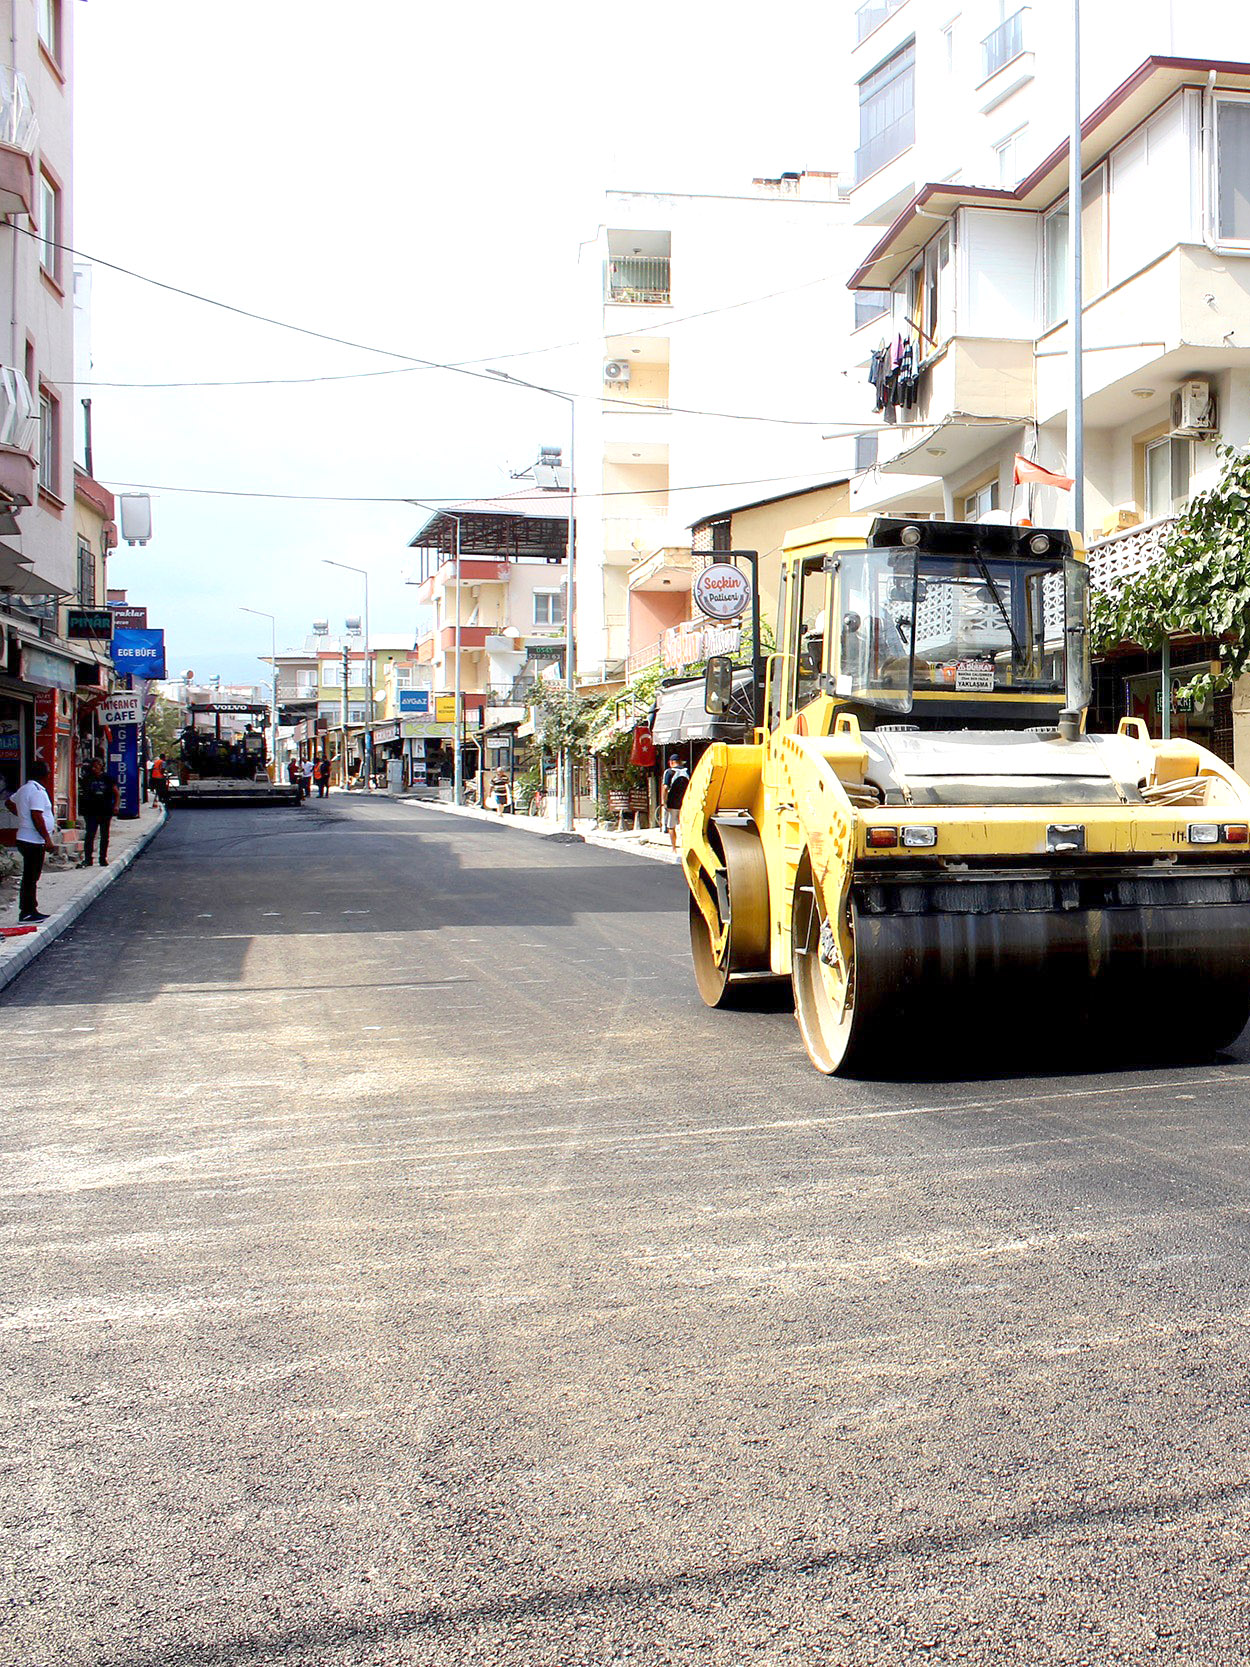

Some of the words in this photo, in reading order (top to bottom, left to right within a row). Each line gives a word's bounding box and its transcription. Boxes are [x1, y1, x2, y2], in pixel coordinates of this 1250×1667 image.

[704, 576, 741, 591] Seçkin
[115, 609, 145, 617] raklar
[117, 648, 134, 657] EGE
[135, 647, 157, 658] BÜFE
[105, 710, 136, 722] CAFE
